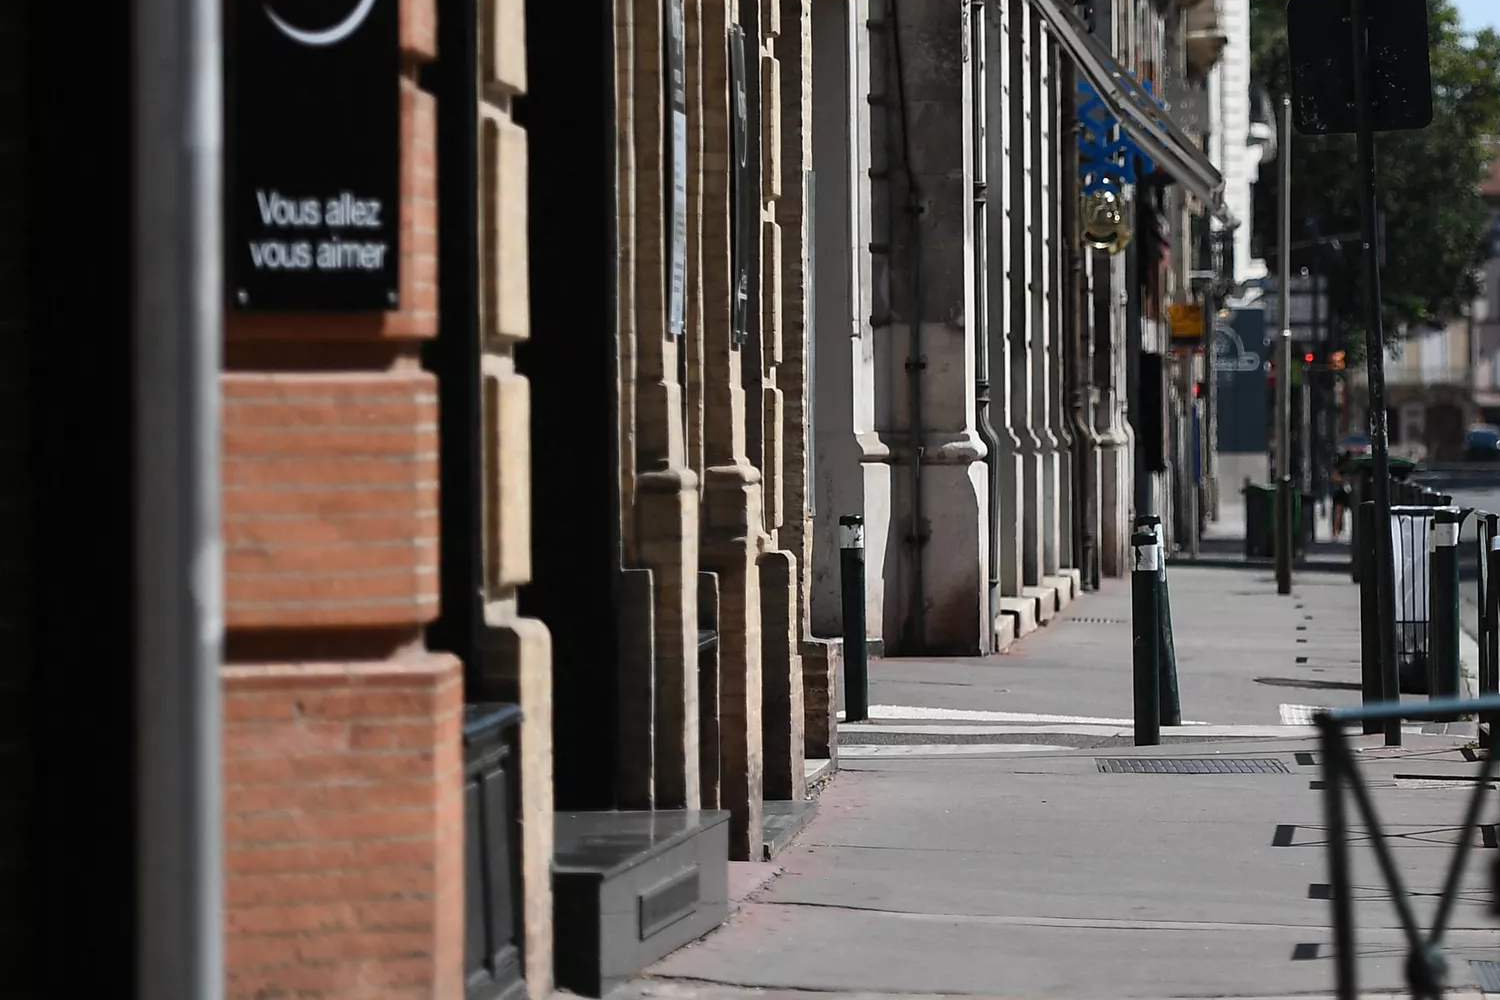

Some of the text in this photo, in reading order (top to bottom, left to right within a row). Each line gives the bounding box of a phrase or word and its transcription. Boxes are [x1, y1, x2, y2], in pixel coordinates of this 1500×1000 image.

[256, 189, 382, 228] Vous allez
[249, 234, 388, 271] vous aimer
